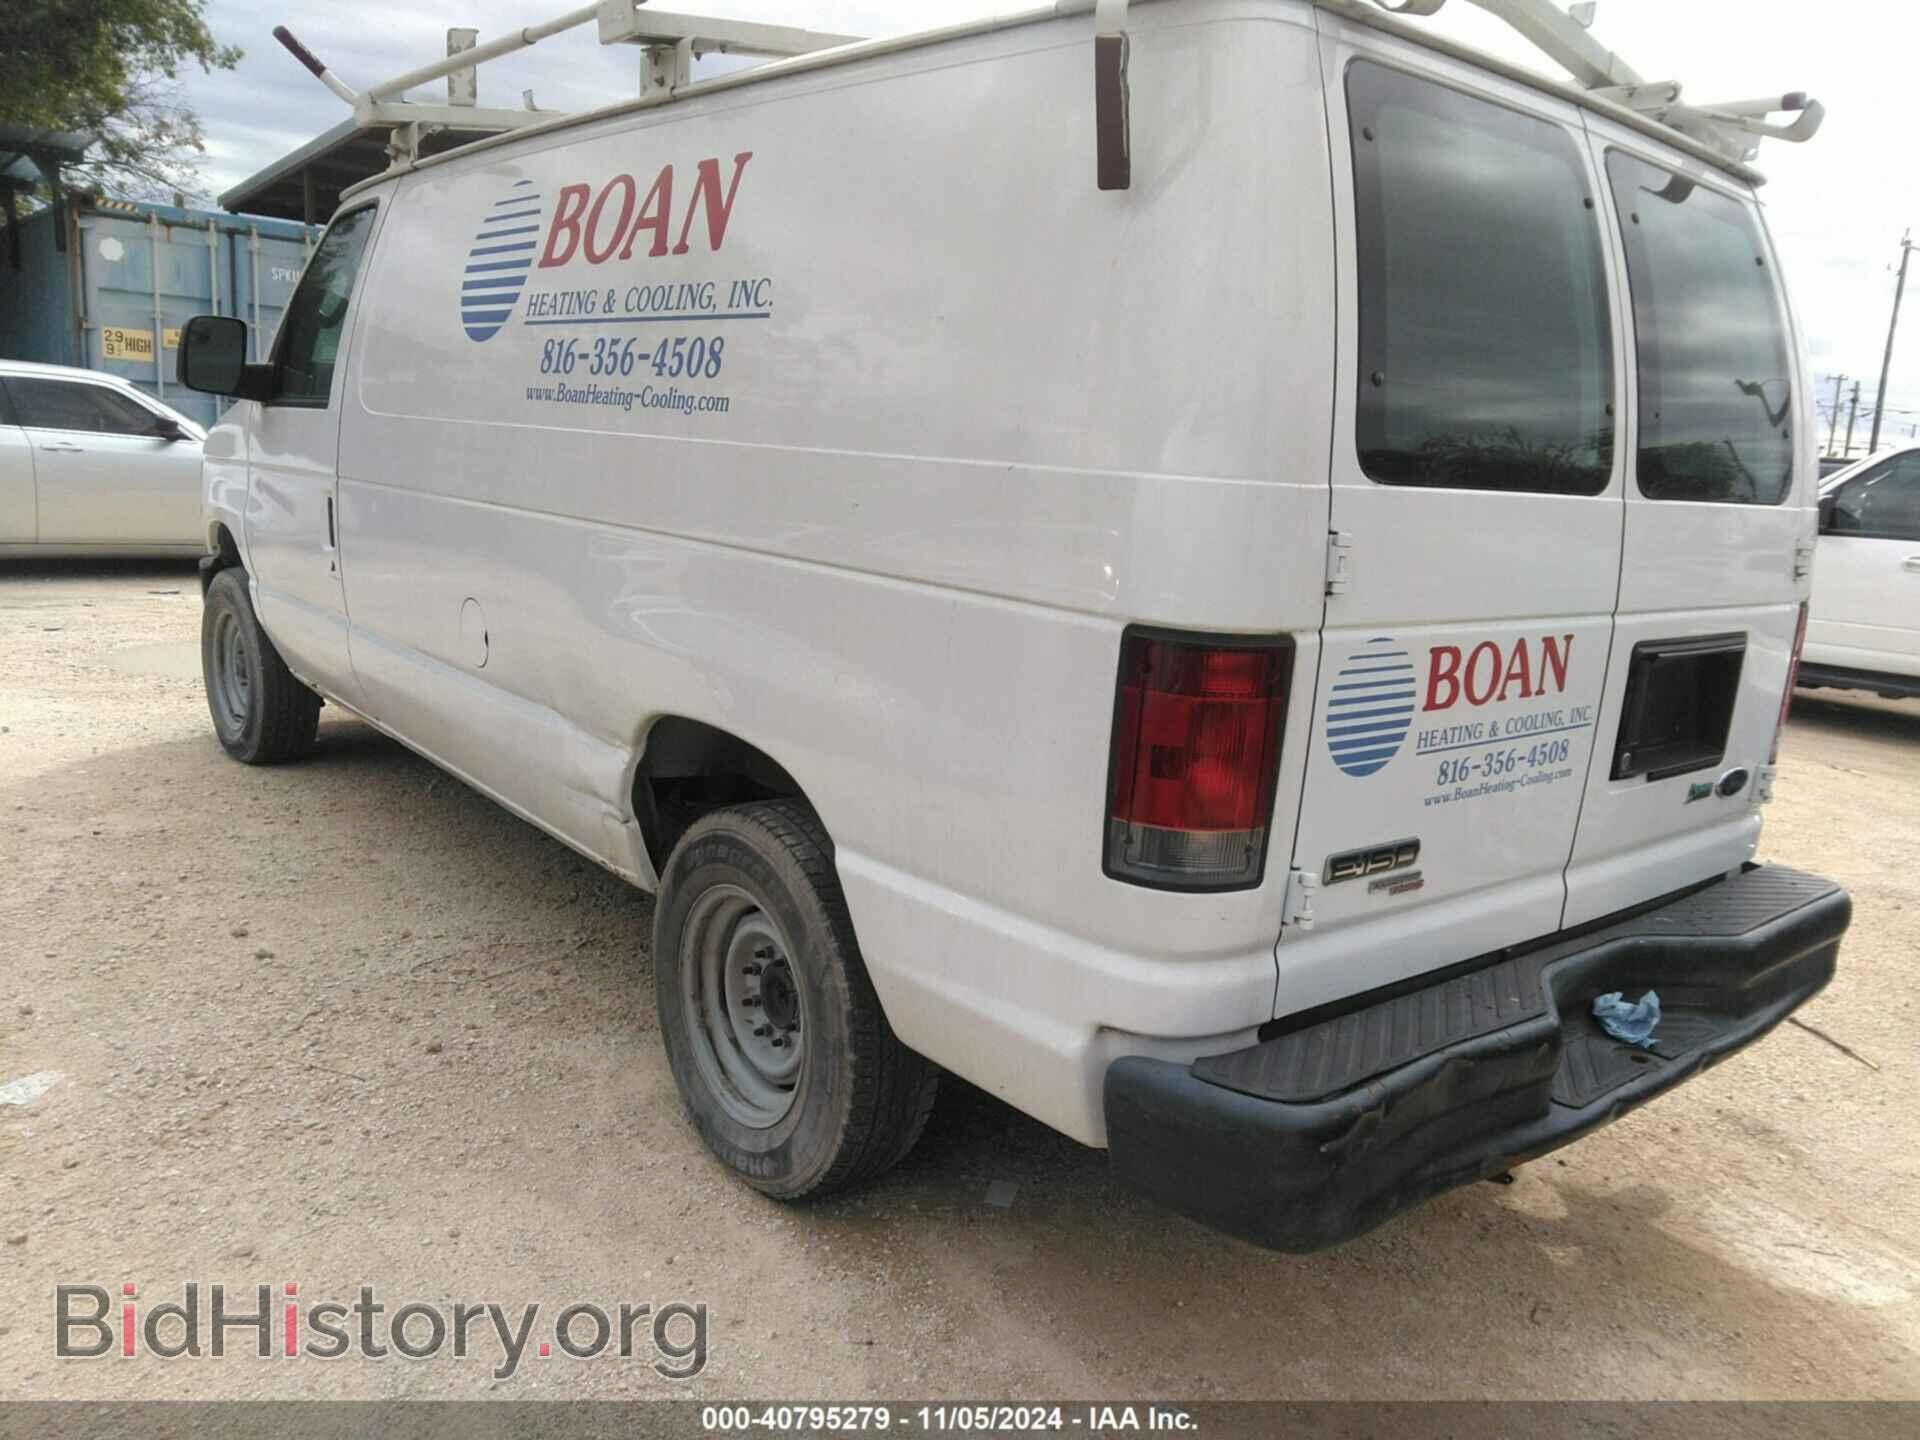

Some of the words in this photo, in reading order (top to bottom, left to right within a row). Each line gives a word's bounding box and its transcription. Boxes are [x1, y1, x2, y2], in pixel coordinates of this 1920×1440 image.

[537, 151, 753, 269] BOAN
[525, 289, 597, 317] HEATING
[602, 288, 617, 314] &
[624, 281, 718, 314] COOLING,
[727, 277, 774, 309] INC.
[125, 336, 152, 353] HIGH
[540, 336, 725, 379] 816-356-4508
[525, 382, 730, 415] www.BoanHeating-Cooling.com
[1422, 633, 1575, 713] BOAN
[1416, 722, 1484, 750] HEATING
[1488, 720, 1500, 738] &
[1436, 738, 1570, 786] 816-356-4508
